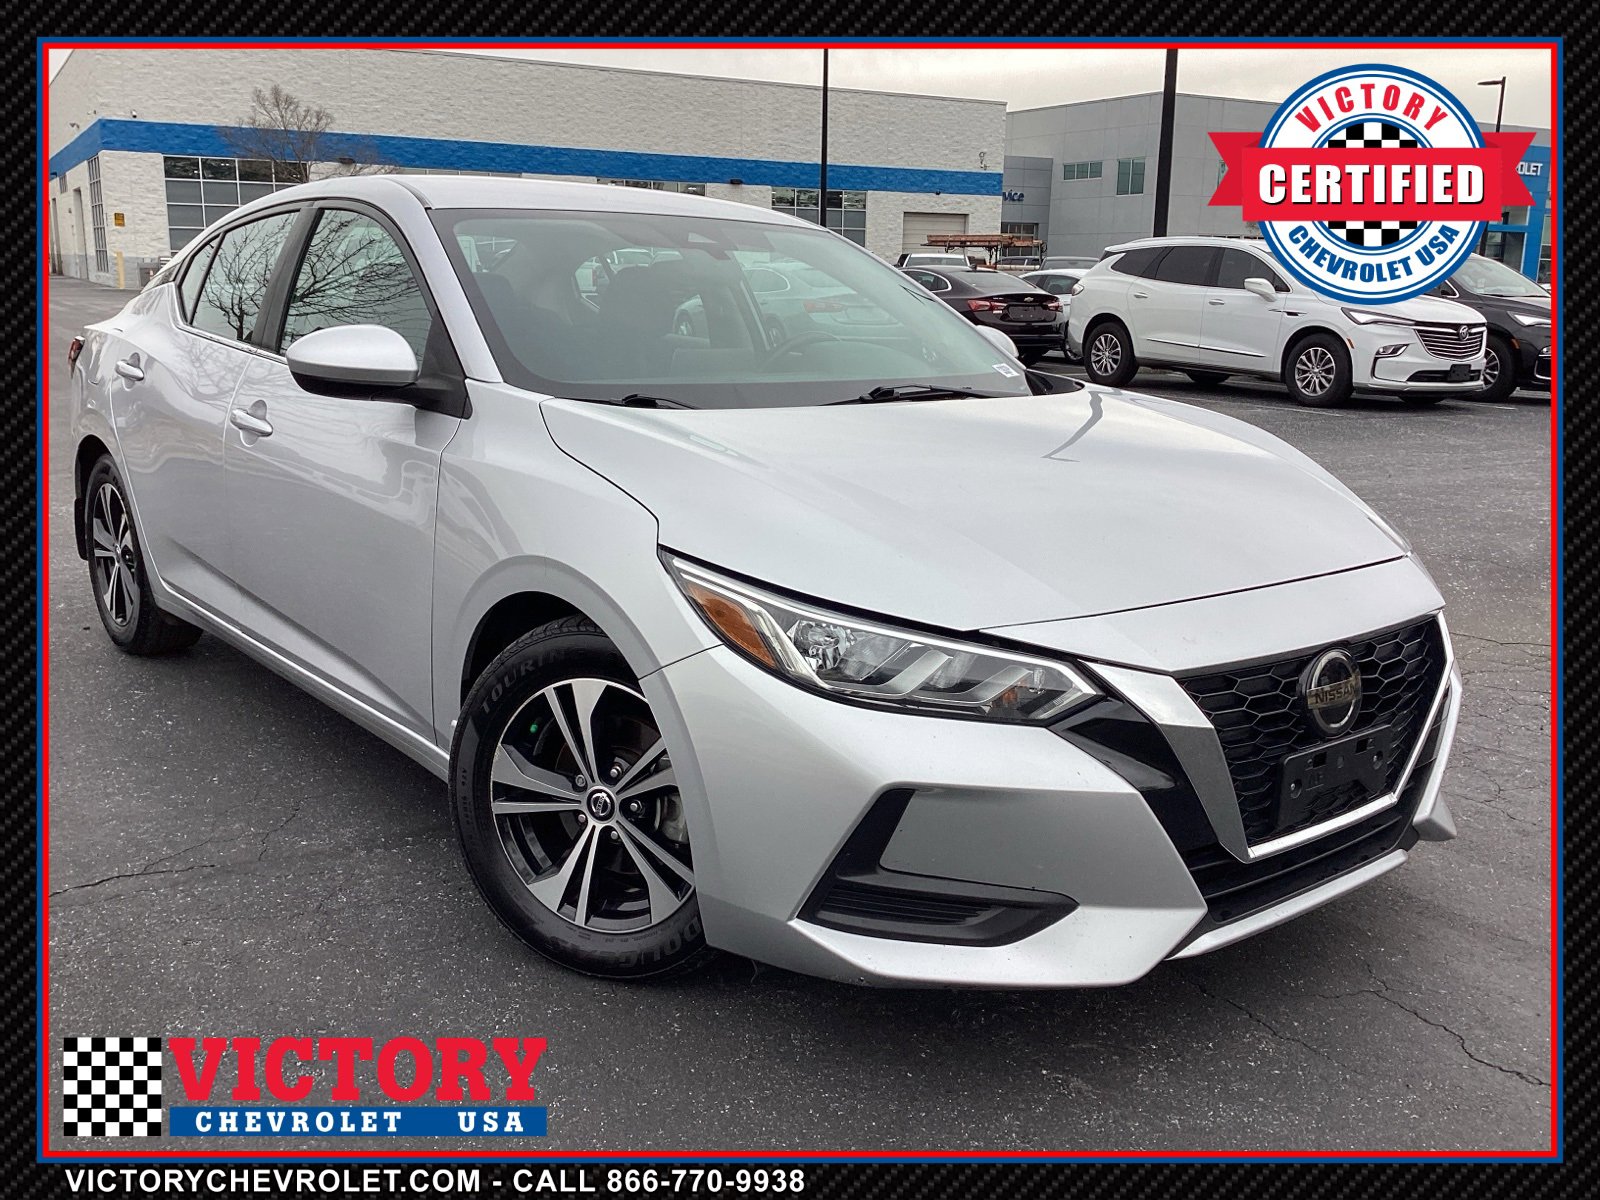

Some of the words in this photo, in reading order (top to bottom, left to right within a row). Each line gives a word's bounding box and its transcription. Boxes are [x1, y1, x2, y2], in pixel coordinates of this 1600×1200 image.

[1516, 161, 1543, 176] OLET
[1002, 189, 1025, 202] vice
[480, 649, 566, 715] TOURIN
[1314, 682, 1355, 704] NISSAN
